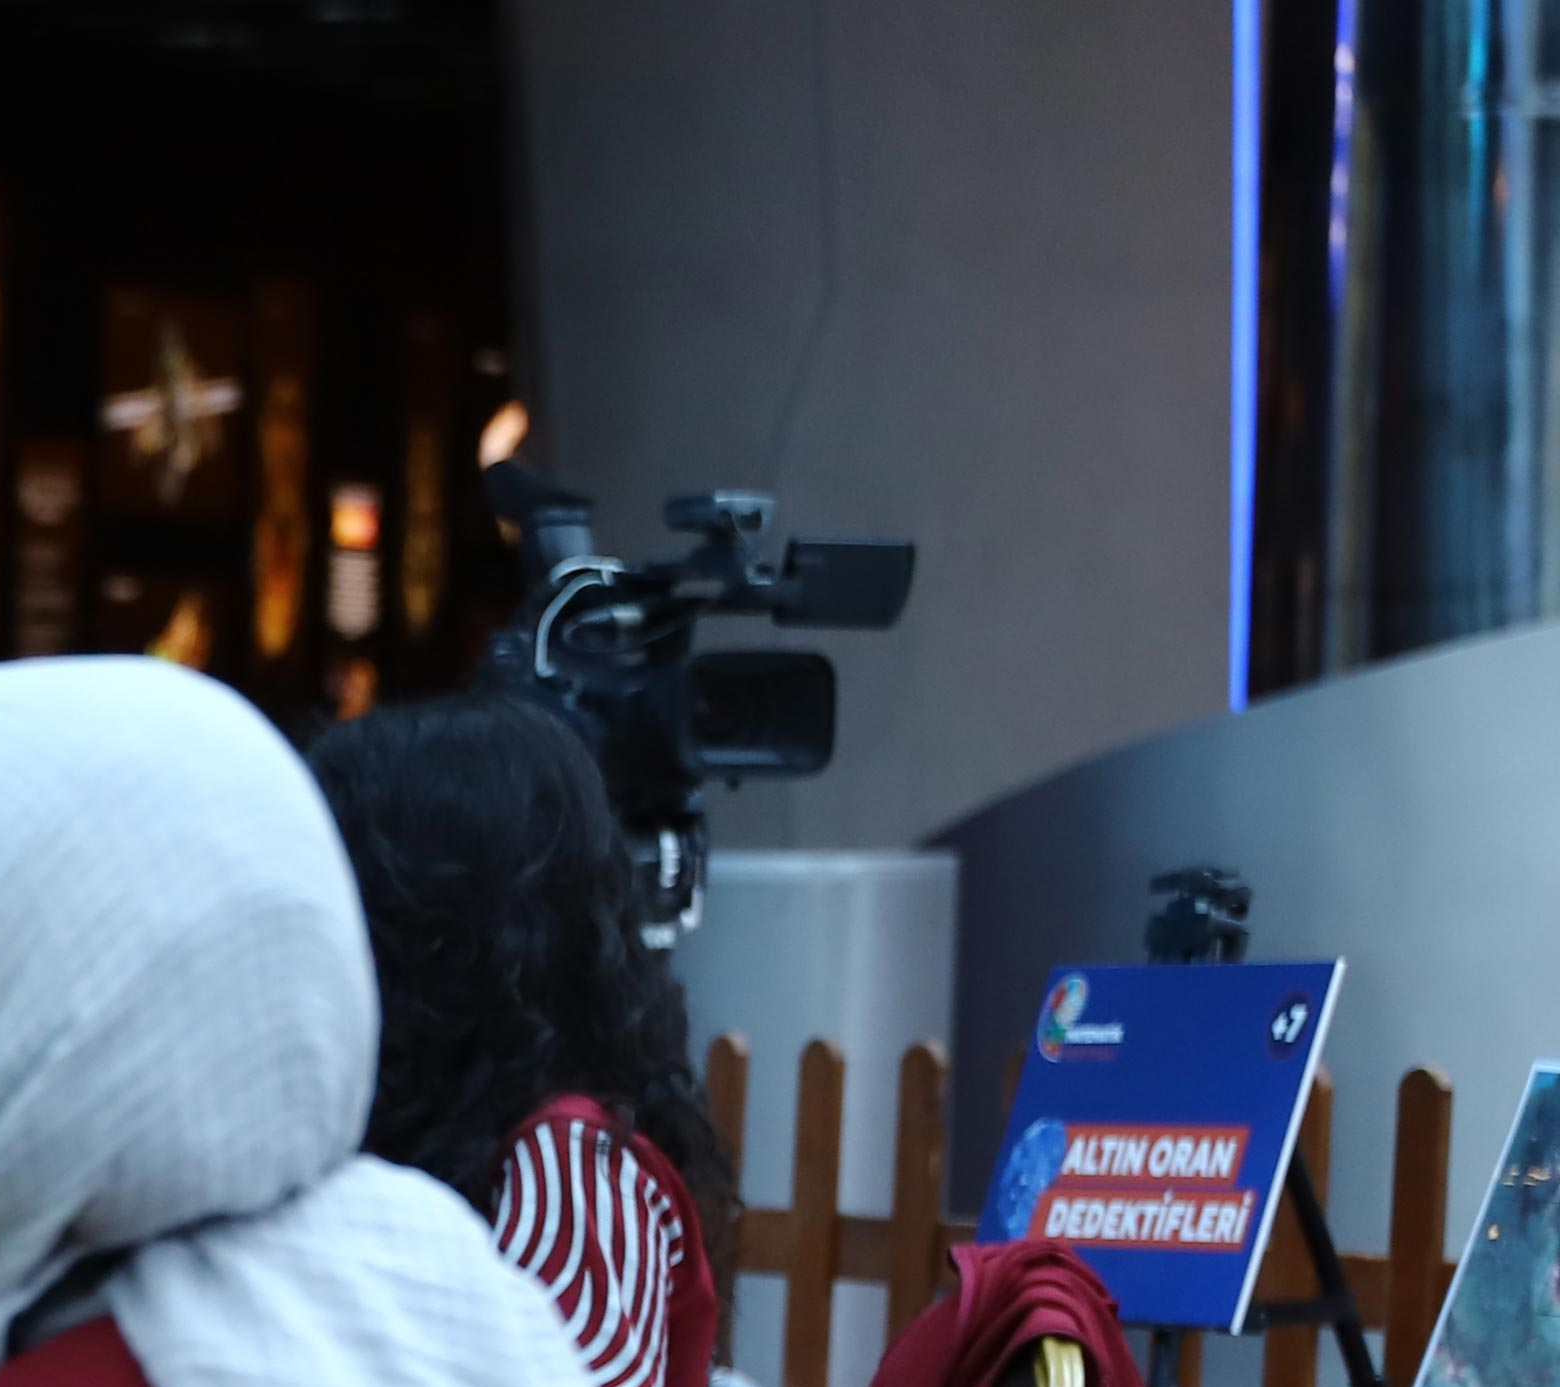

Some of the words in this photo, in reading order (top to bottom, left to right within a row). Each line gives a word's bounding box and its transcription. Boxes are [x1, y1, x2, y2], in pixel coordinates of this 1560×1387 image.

[1271, 1003, 1308, 1043] +7
[1062, 1134, 1150, 1177] ALTIN
[1148, 1135, 1239, 1179] ORAN
[1044, 1188, 1255, 1244] DEDEKTİFLERİ
